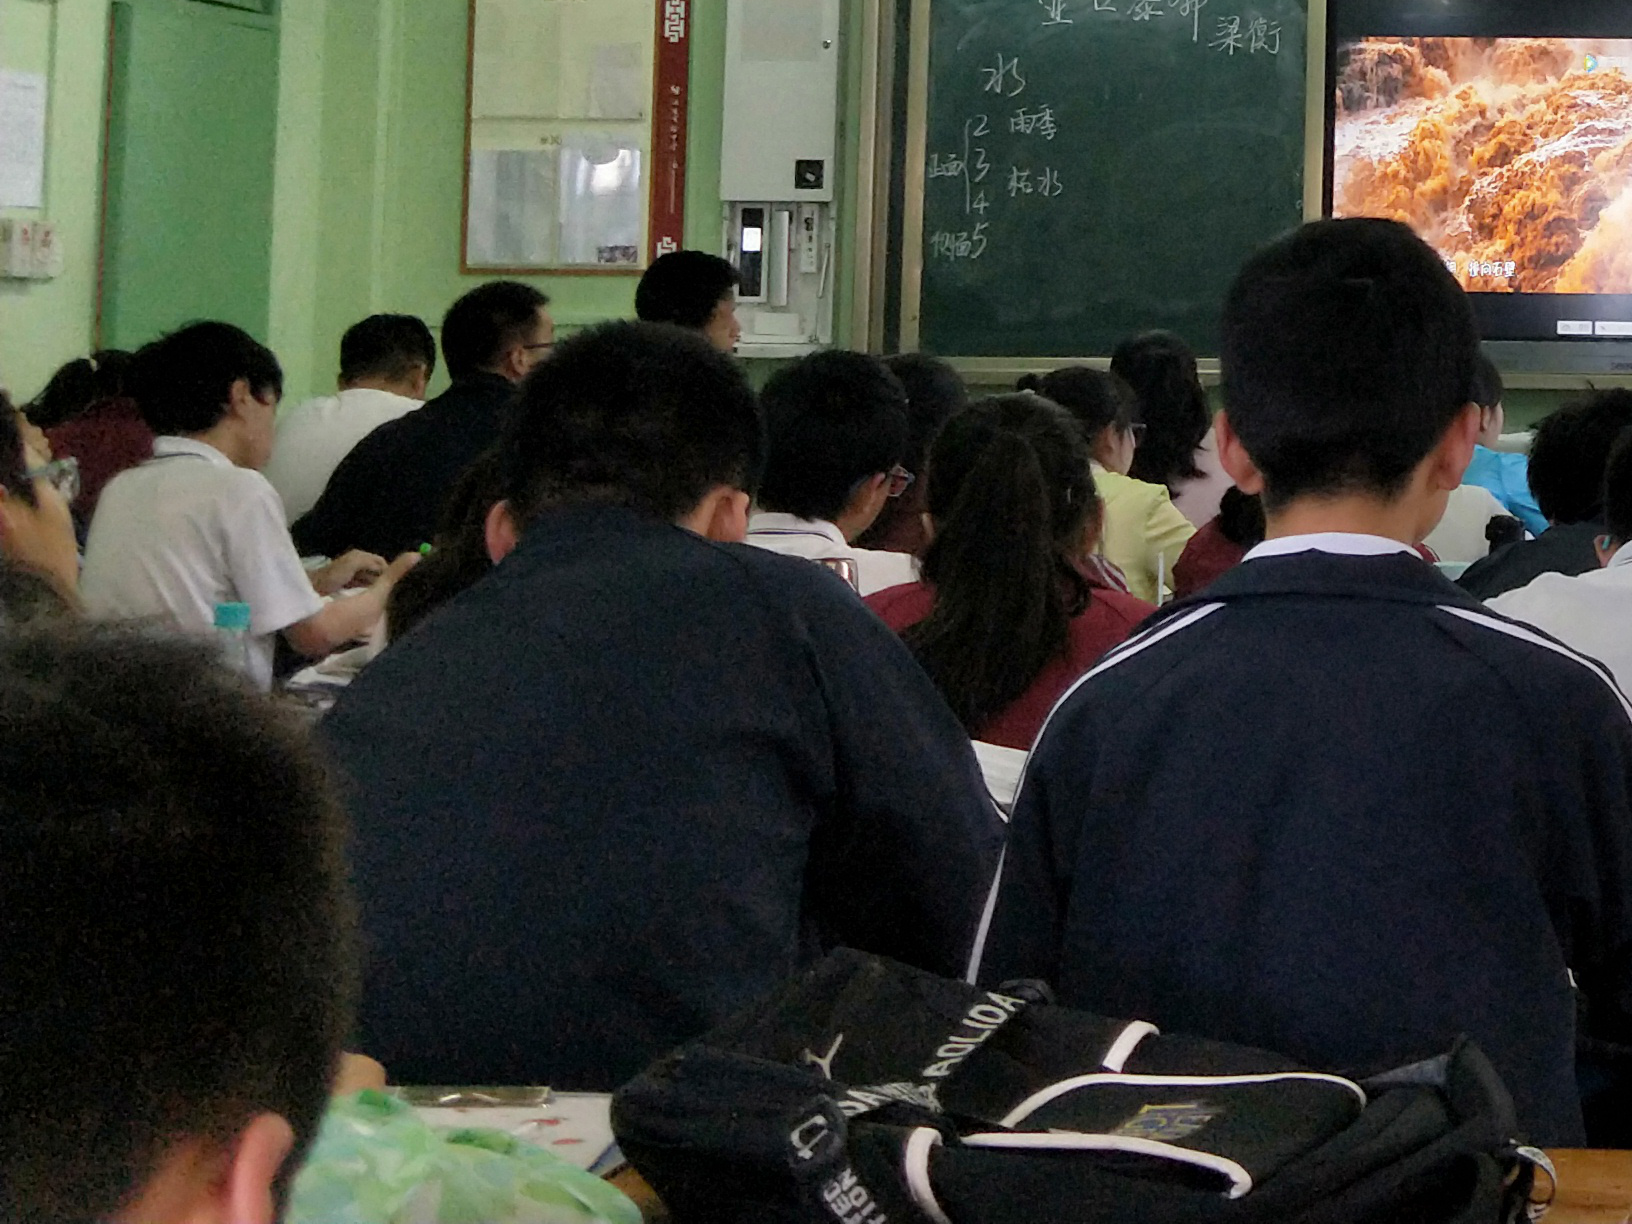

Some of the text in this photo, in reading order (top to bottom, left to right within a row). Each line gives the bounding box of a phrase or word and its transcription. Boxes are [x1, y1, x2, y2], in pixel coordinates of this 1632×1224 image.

[981, 52, 1027, 98] 水
[972, 113, 991, 139] 2
[1008, 103, 1058, 141] 雨季
[973, 147, 990, 182] 3
[971, 188, 990, 215] 4
[970, 221, 990, 259] 5
